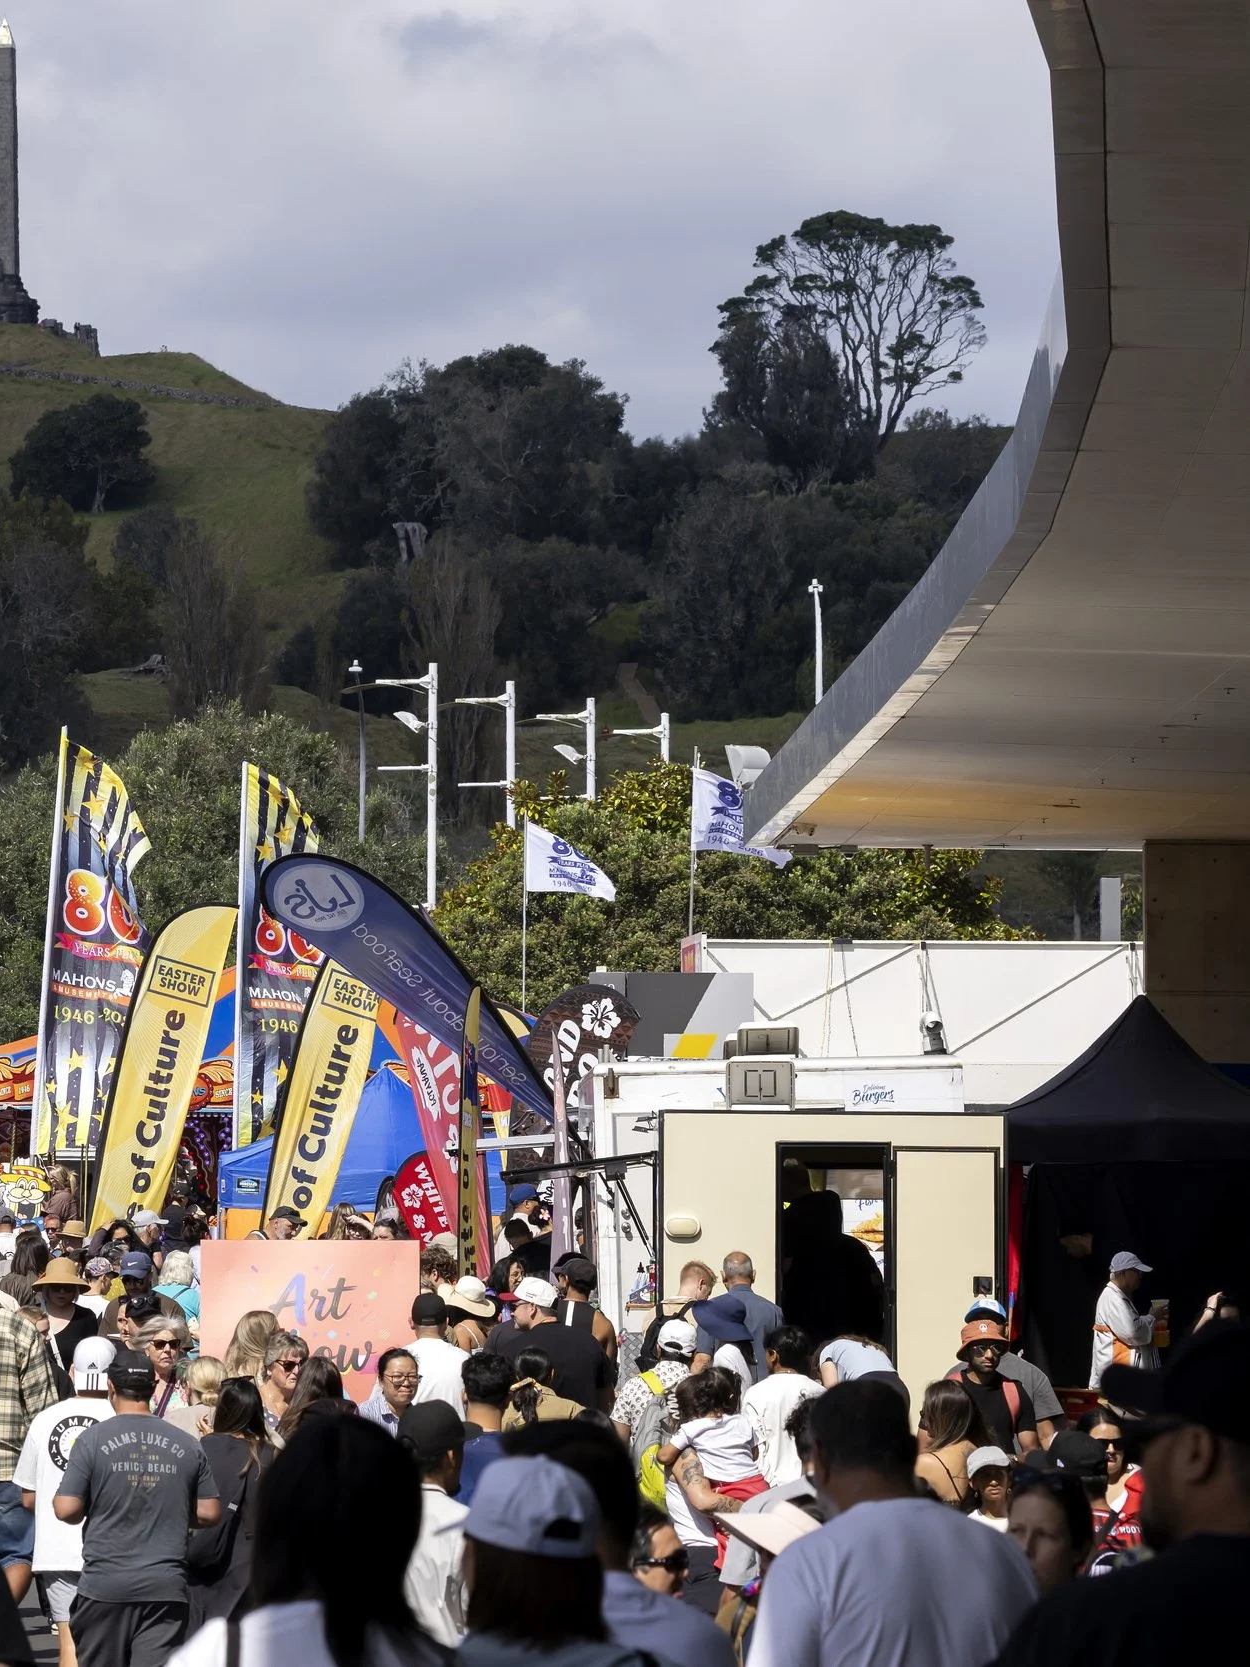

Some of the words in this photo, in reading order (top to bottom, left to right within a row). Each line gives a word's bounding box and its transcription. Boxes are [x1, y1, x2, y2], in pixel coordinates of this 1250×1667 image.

[710, 822, 743, 835] MAHON
[74, 942, 111, 958] YEARS
[52, 967, 117, 992] MAHONS
[158, 965, 206, 986] EASTER
[159, 977, 201, 997] SHOW
[249, 986, 301, 1003] MAHON
[333, 978, 382, 1004] EASTER
[334, 992, 377, 1013] SHOW
[54, 1005, 95, 1025] 1946
[260, 1018, 298, 1033] 1946
[135, 1009, 187, 1148] Culture
[298, 1023, 359, 1162] Culture
[852, 1088, 895, 1105] Burgers
[131, 1152, 156, 1195] of
[291, 1166, 318, 1210] of
[414, 1161, 448, 1228] WHITE
[268, 1273, 358, 1326] Art
[101, 1431, 138, 1456] PALMS
[140, 1431, 169, 1449] LUXE
[170, 1443, 186, 1459] CO
[112, 1461, 145, 1473] VENICE
[147, 1462, 178, 1474] BEACH
